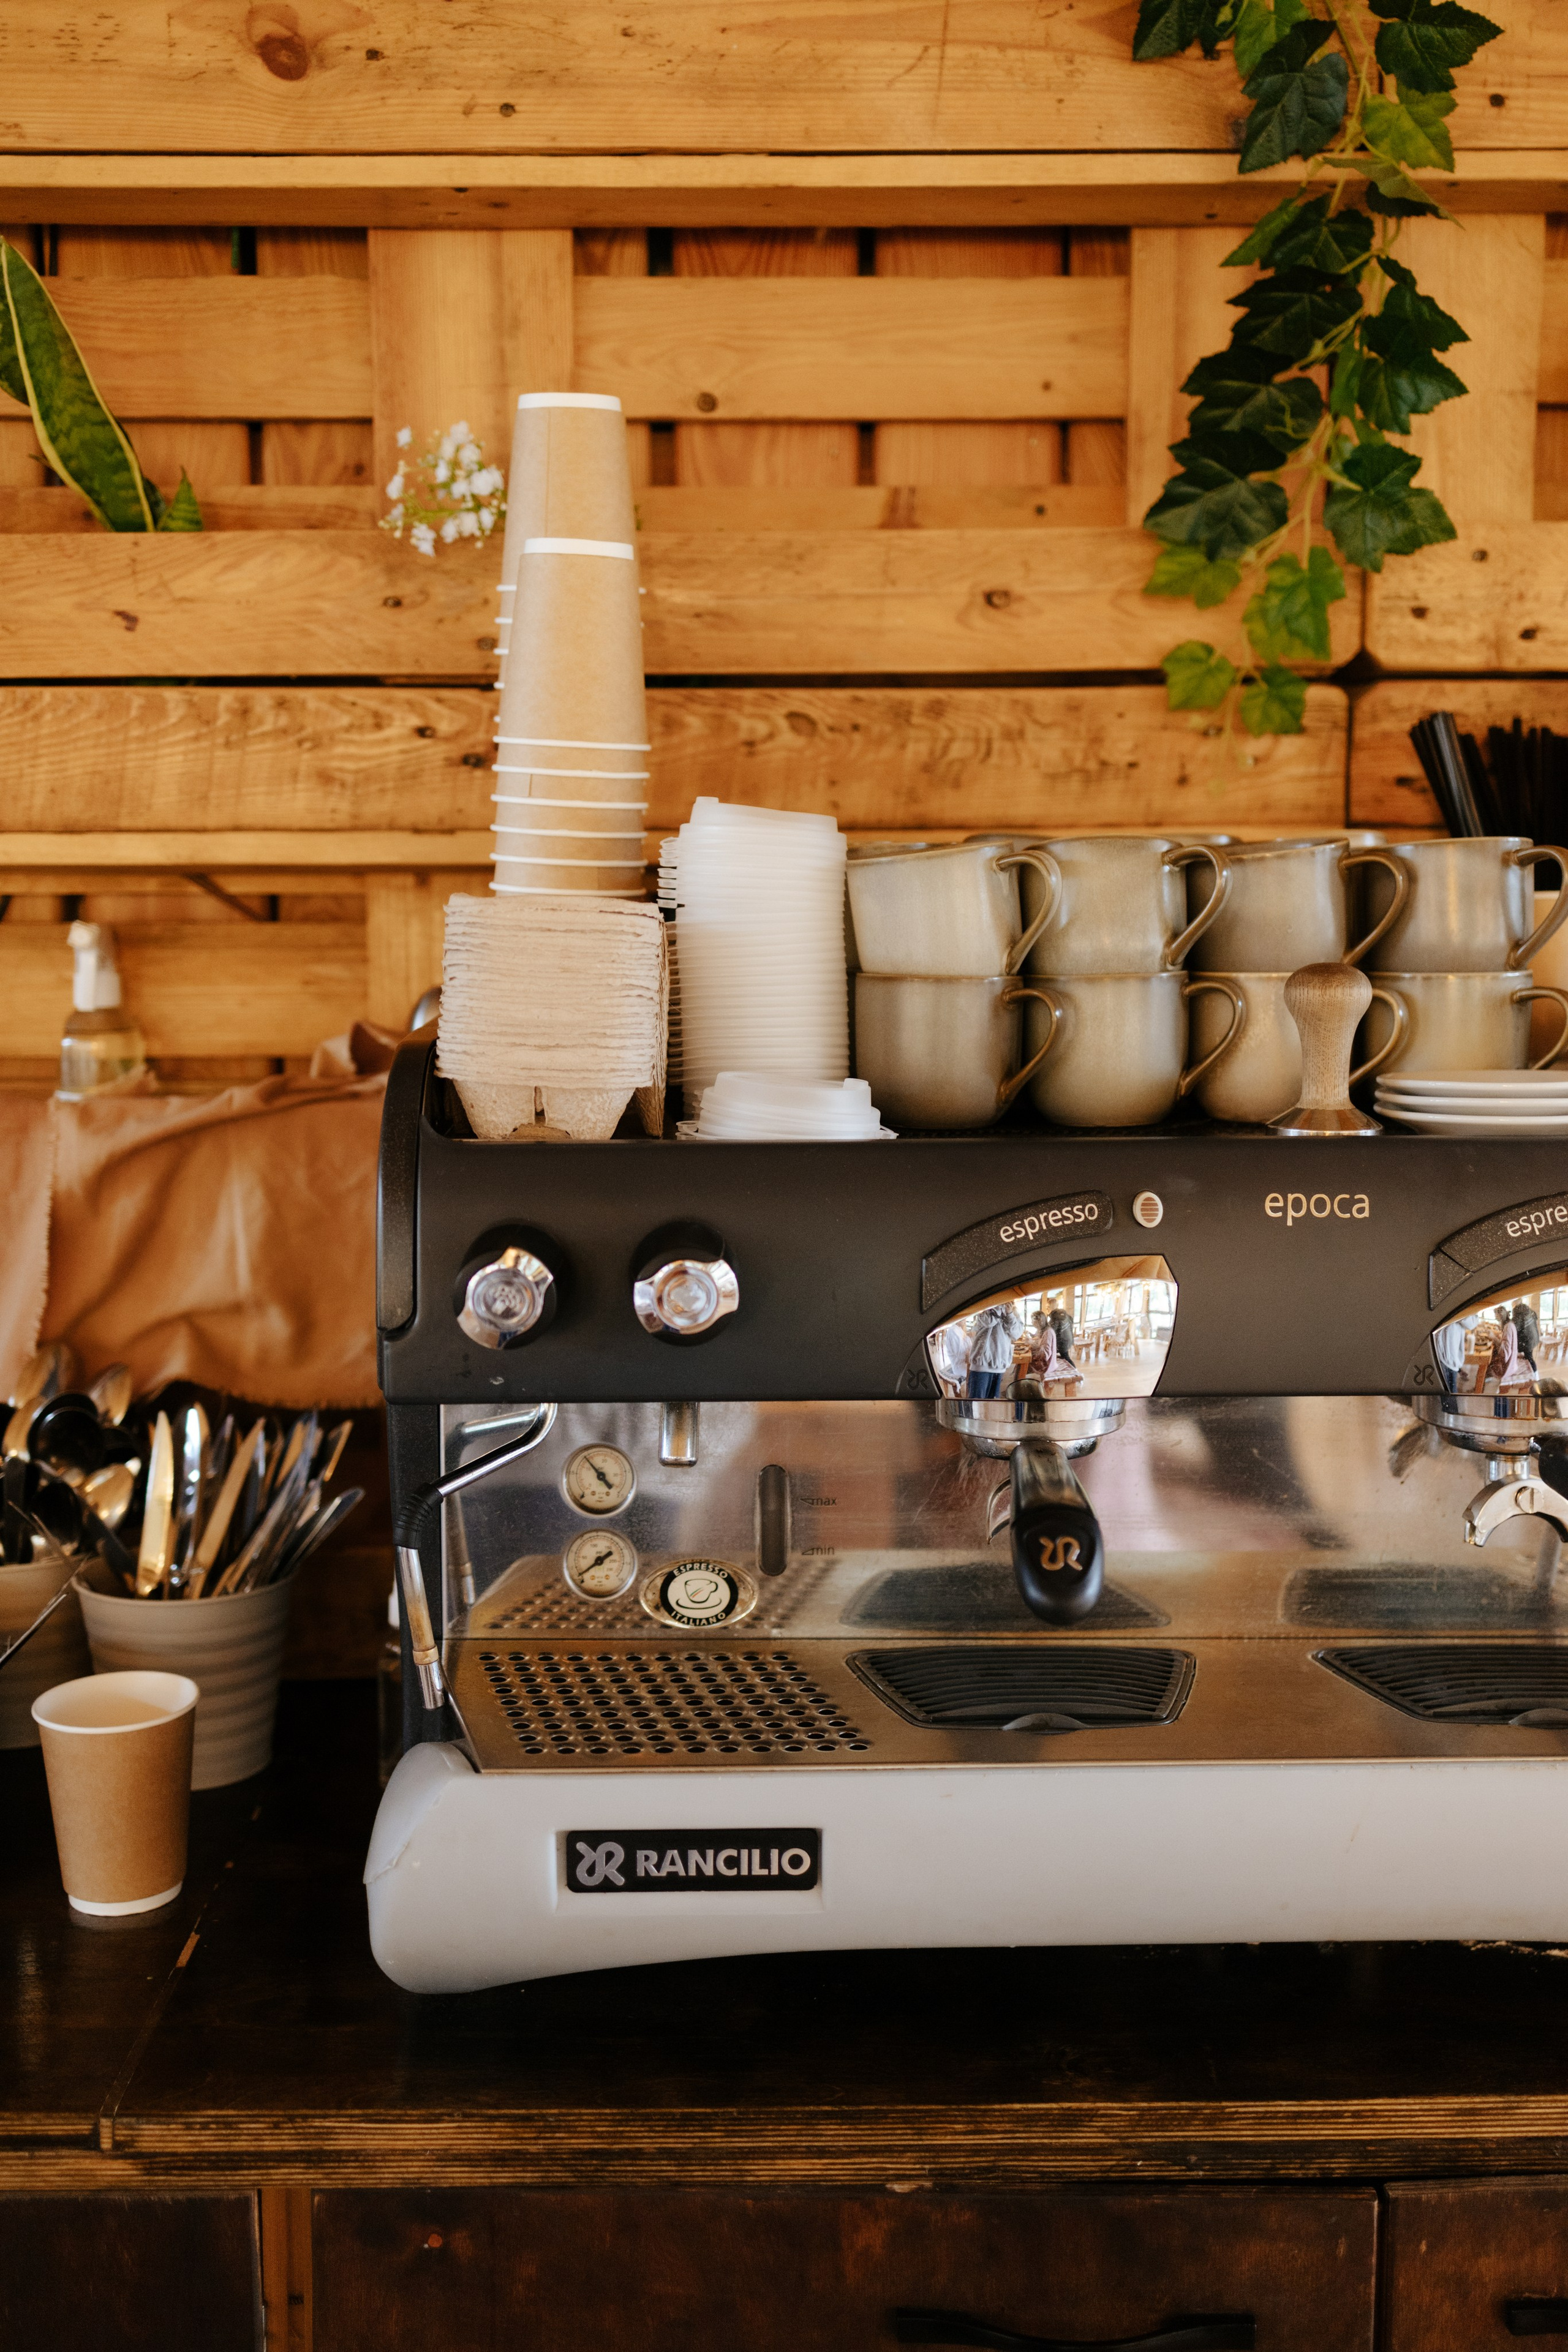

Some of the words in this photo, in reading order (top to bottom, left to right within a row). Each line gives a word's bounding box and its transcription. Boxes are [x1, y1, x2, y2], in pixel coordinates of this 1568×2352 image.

[1000, 1204, 1098, 1242] espresso
[1265, 1193, 1370, 1226] epoca
[1507, 1205, 1568, 1237] espre
[673, 1562, 728, 1578] ESPRESSO
[671, 1611, 726, 1626] ITALIANO
[636, 1848, 811, 1876] RANCILIO
